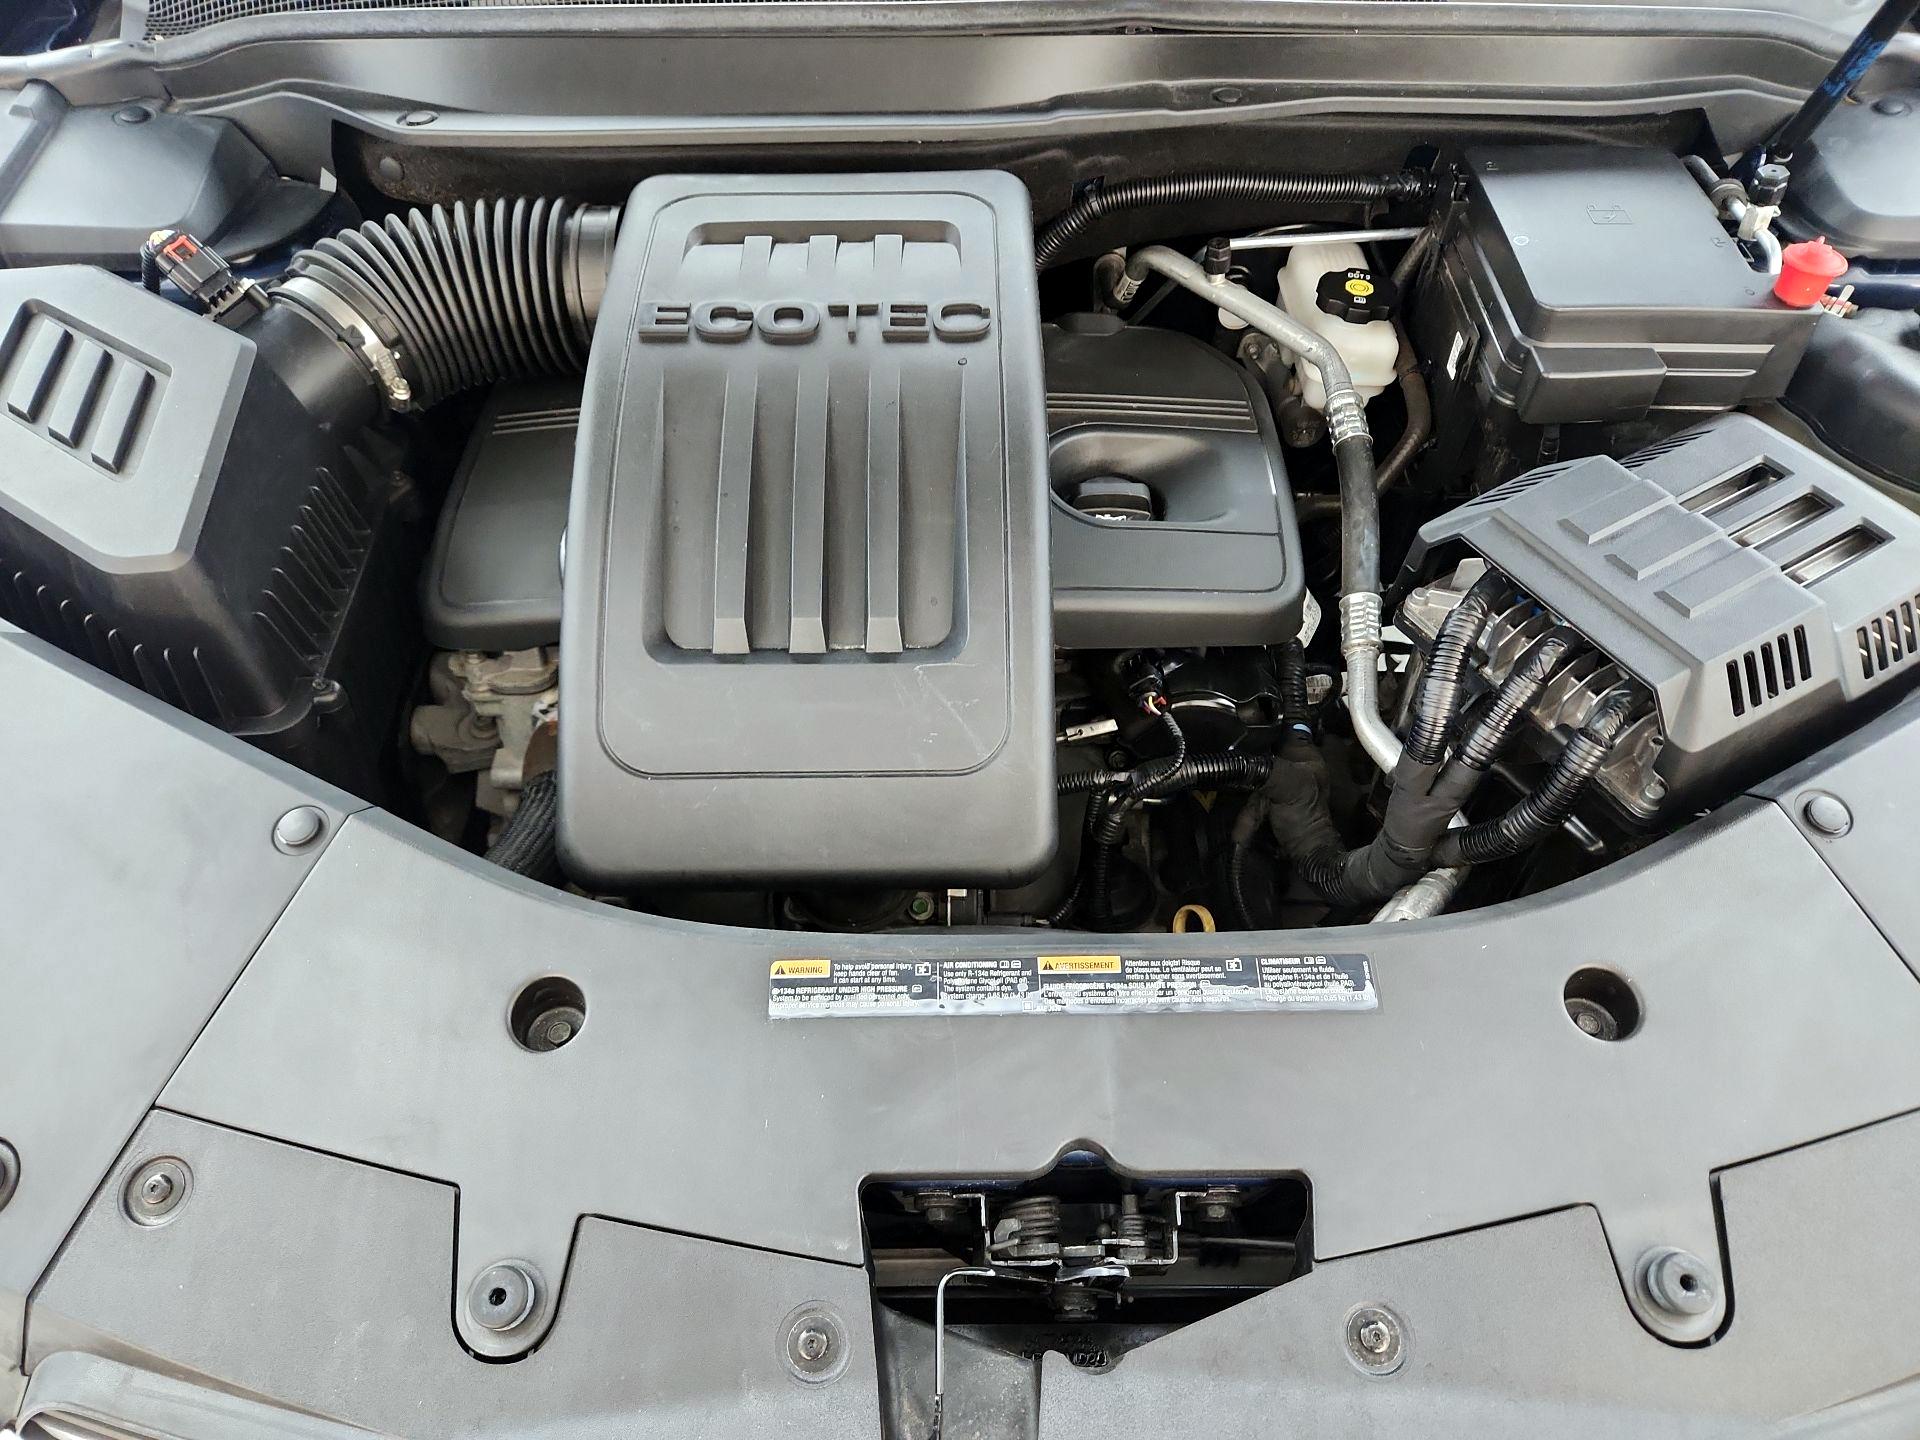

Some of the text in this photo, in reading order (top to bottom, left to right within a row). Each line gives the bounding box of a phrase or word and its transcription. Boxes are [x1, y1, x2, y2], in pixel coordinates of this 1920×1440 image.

[637, 301, 992, 343] ECOTEC
[834, 963, 840, 971] To
[841, 963, 854, 971] help
[943, 961, 998, 969] AIR CONDITIONING
[1055, 961, 1114, 970] AVERTISSEMENT
[788, 966, 823, 974] WARNING
[834, 970, 847, 978] keep
[882, 970, 888, 978] of
[955, 970, 966, 978] only
[990, 970, 1020, 978] Refrigerant
[796, 986, 838, 994] REFRIGERANT
[876, 985, 908, 993] PRESSURE
[944, 985, 954, 993] The
[956, 985, 976, 993] system
